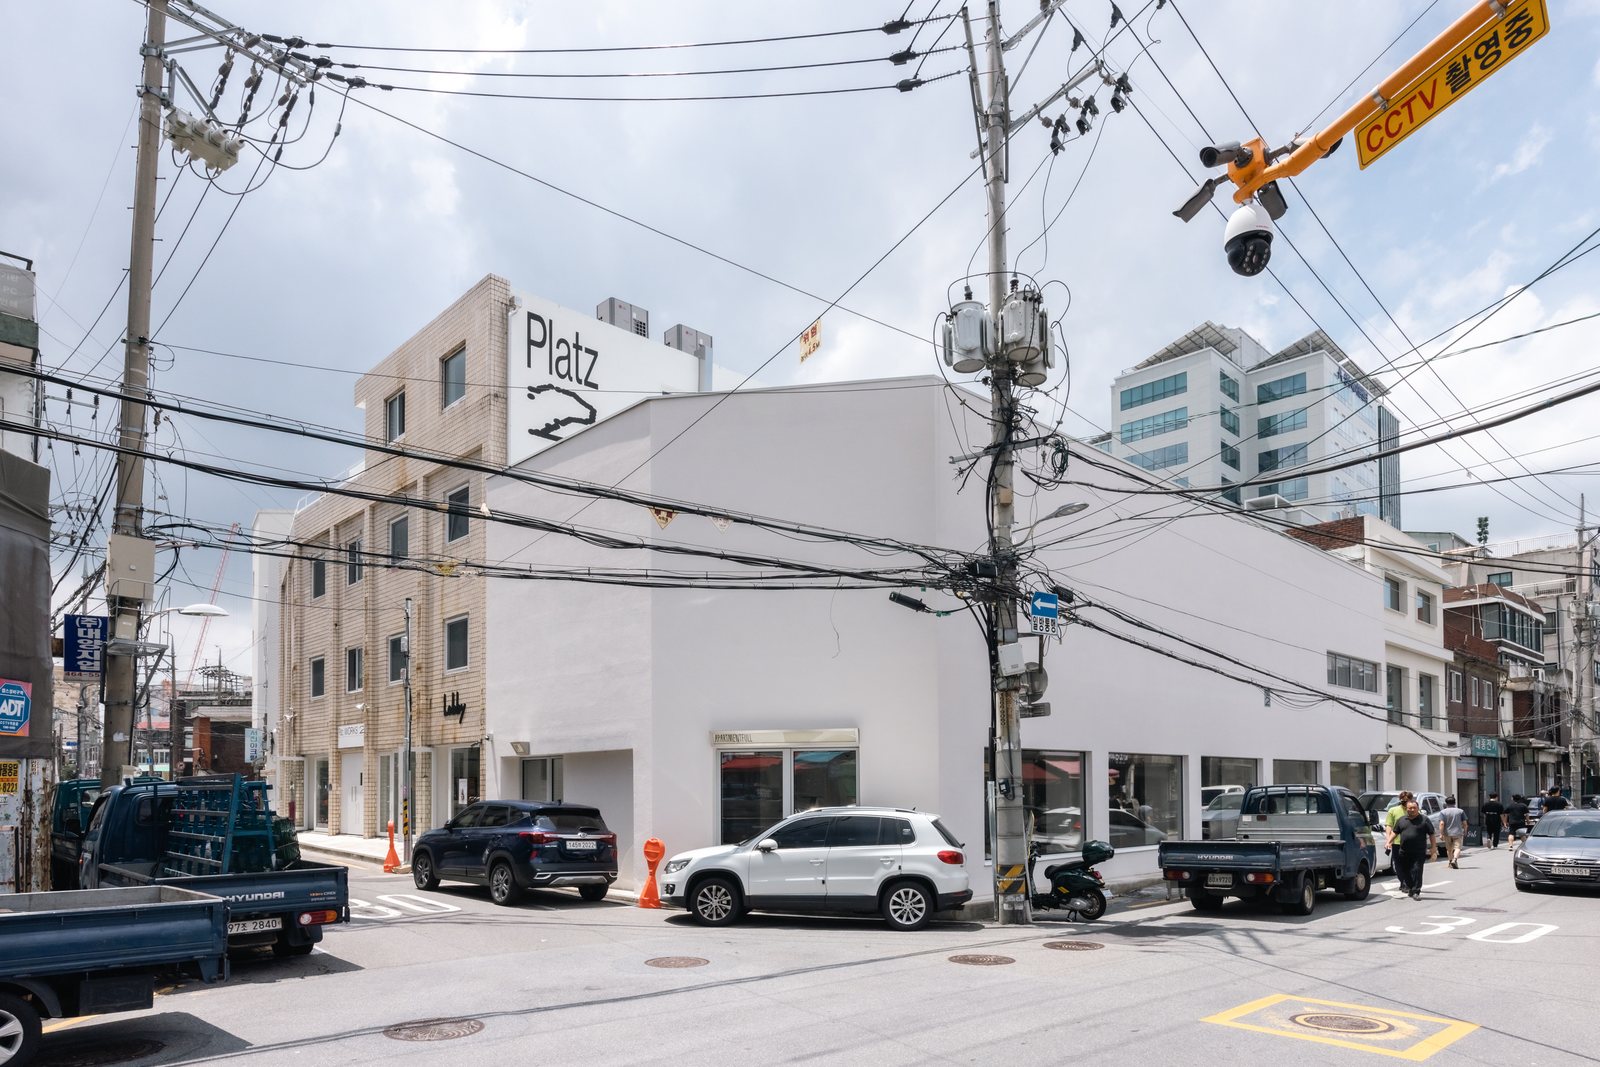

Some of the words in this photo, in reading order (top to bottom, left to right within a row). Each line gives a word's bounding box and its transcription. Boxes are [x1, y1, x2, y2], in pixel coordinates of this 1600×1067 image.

[1366, 79, 1437, 152] CCTV
[1446, 7, 1533, 95] 촬영중
[527, 311, 599, 390] Platz
[0, 699, 25, 717] ADT
[225, 891, 285, 902] HYUNDAI
[252, 920, 277, 930] 2840
[1384, 915, 1560, 943] 30
